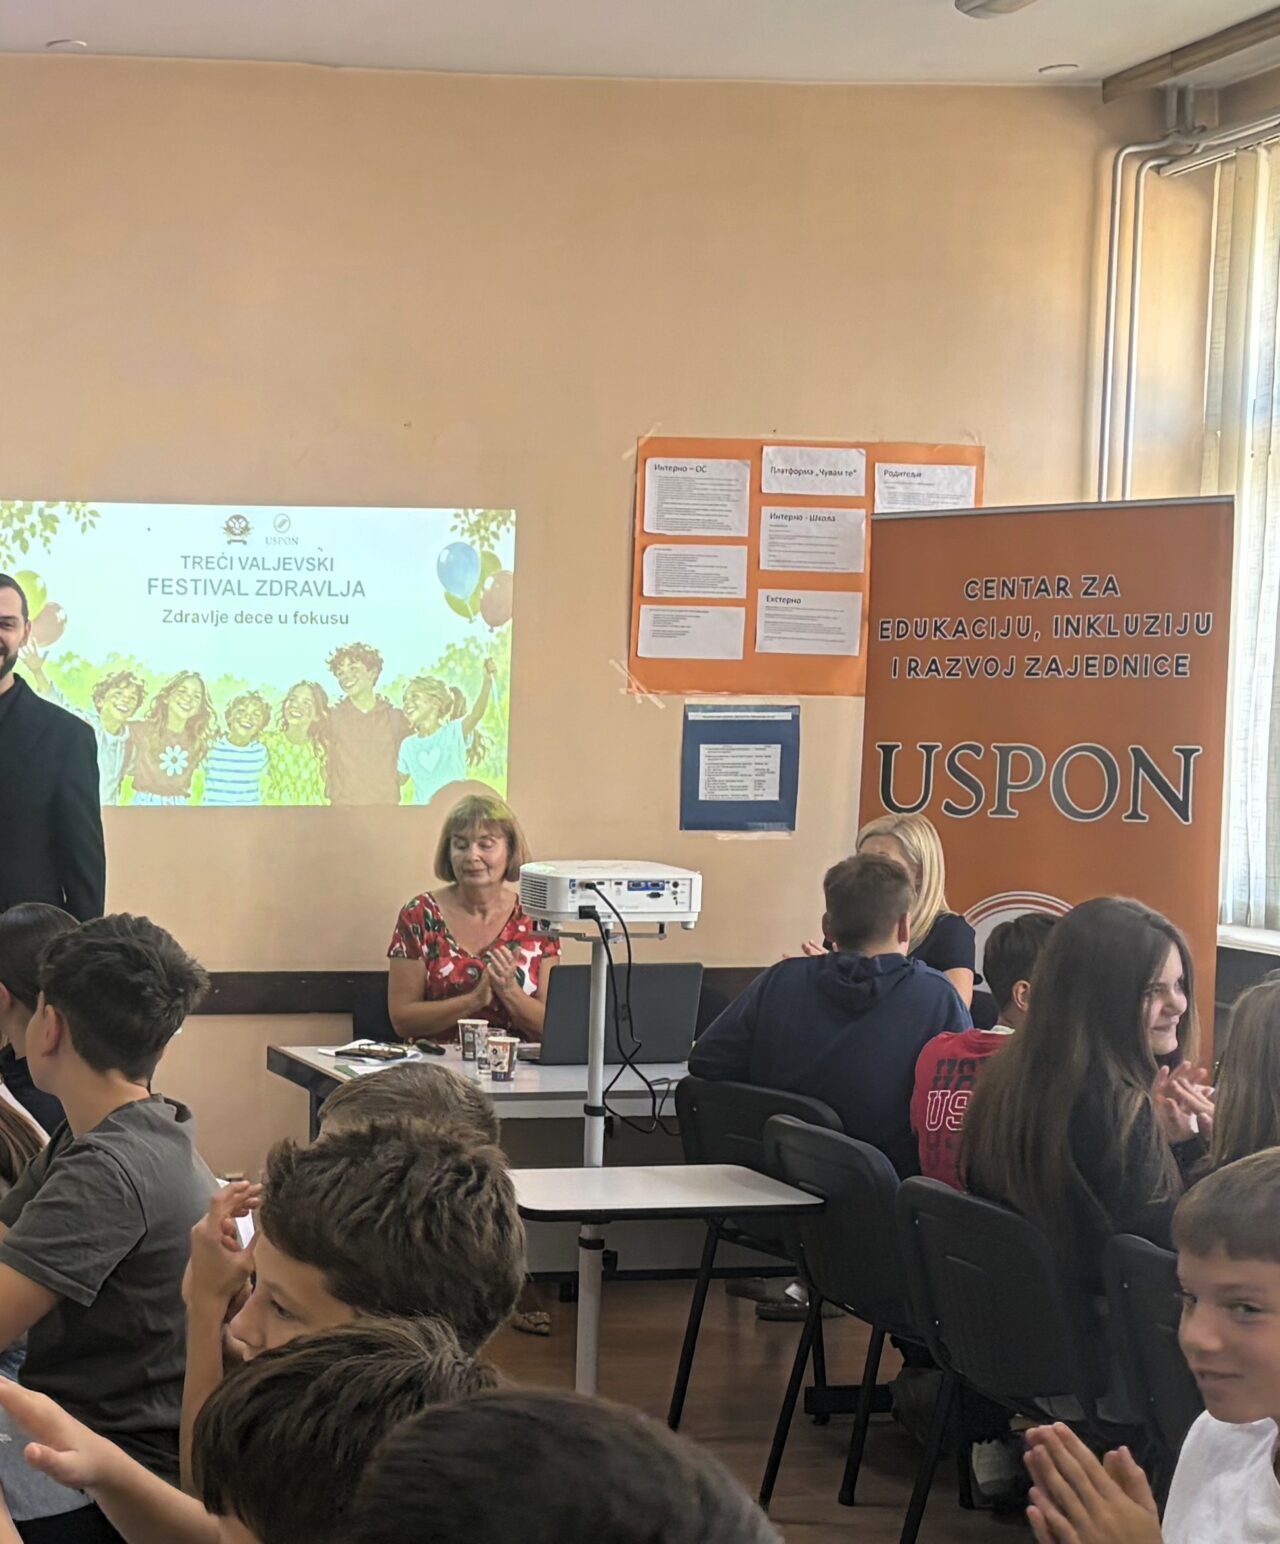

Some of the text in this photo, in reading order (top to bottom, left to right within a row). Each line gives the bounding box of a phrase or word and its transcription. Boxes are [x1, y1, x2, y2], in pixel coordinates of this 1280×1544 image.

[654, 463, 687, 473] Интерно
[695, 465, 707, 473] ОС
[770, 466, 813, 478] Платформа
[769, 512, 803, 522] Интерно
[809, 514, 836, 522] Школа
[265, 536, 299, 546] USPON
[181, 552, 334, 572] TREĆI VALJEVSKI
[147, 577, 366, 598] FESTIVAL ZDRAVLJA
[964, 574, 1121, 600] CENTAR ZA
[162, 609, 349, 627] Zdravlje dece u fokusu
[879, 612, 1213, 642] EDUKACIJU, INKLUZIJU
[892, 654, 1190, 679] I RAZVOJ ZAJEDNICE
[876, 740, 1203, 825] USPON
